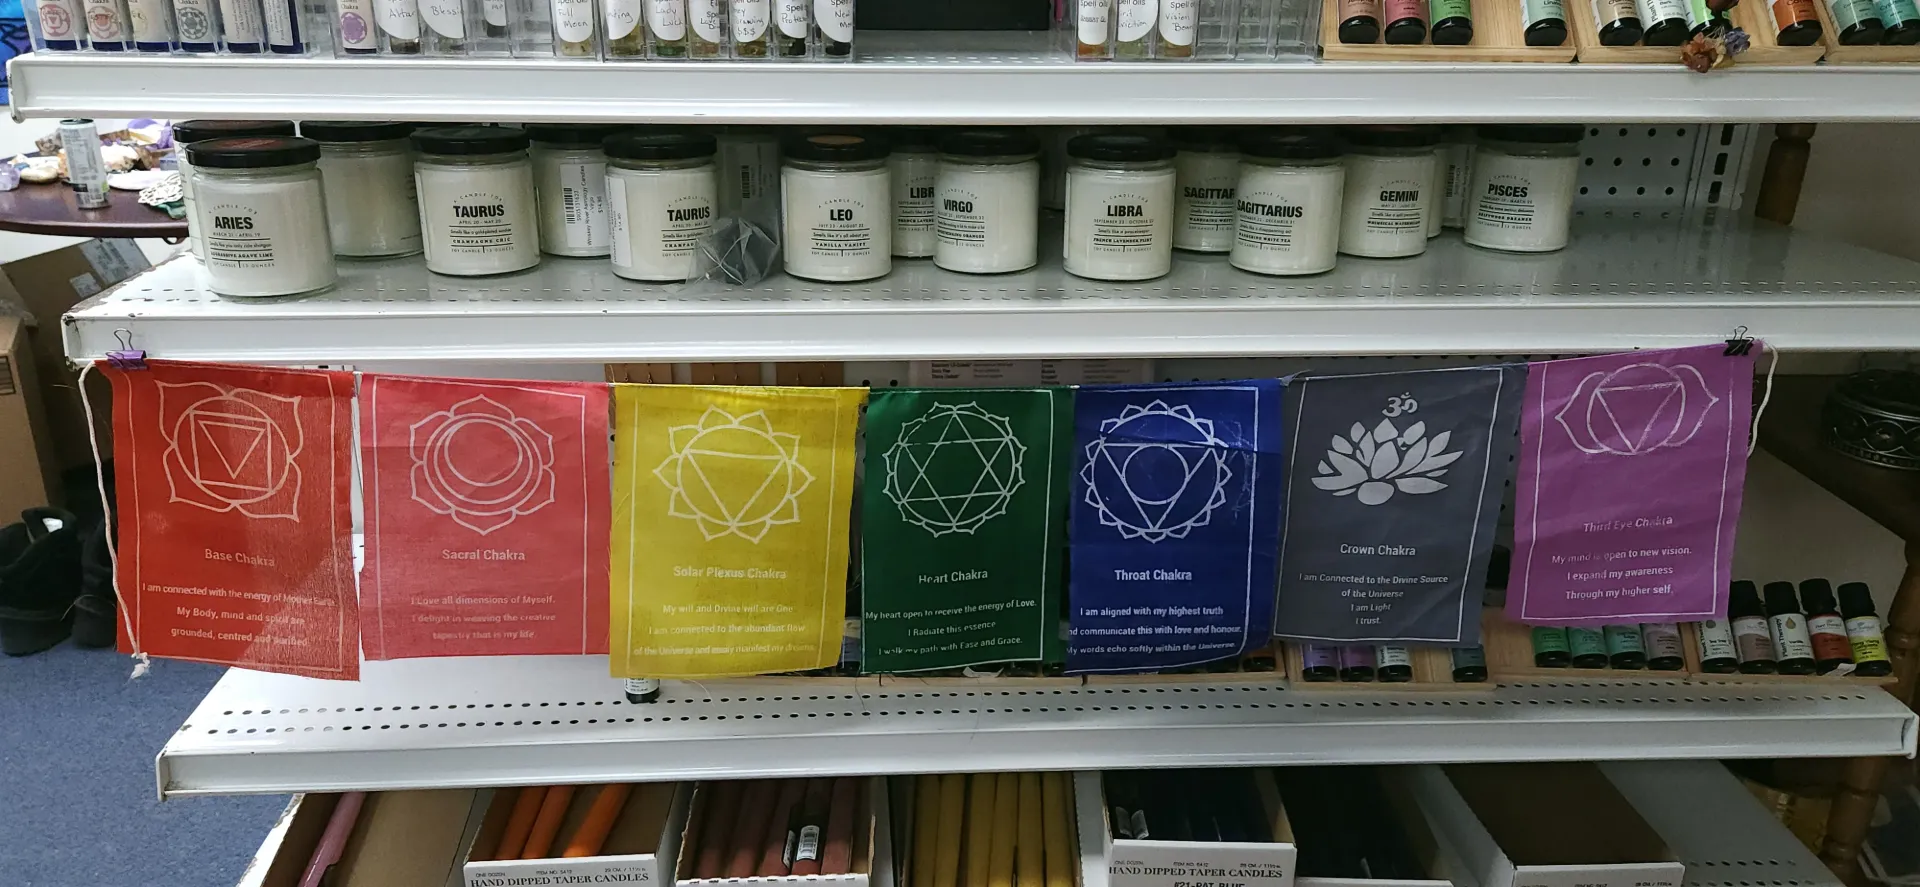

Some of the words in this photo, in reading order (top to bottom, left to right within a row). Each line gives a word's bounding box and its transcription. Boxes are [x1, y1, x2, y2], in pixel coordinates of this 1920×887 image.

[655, 3, 677, 17] Lady
[1165, 12, 1190, 20] Vision
[910, 187, 934, 199] LIBR
[1380, 190, 1419, 202] GEMINI
[1488, 183, 1528, 198] PISCES
[453, 204, 504, 218] TAURUS
[944, 198, 973, 213] VIRGO
[1107, 205, 1143, 217] LIBRA
[1237, 199, 1303, 218] SAGITTARIUS
[667, 206, 710, 222] TAURUS
[830, 209, 853, 221] LEO
[215, 216, 253, 230] ARIES
[1613, 520, 1633, 530] Eye
[1635, 516, 1673, 528] Chakra
[442, 549, 480, 561] Sacral
[483, 549, 525, 561] Chakra
[1340, 543, 1375, 555] Crown
[1378, 544, 1416, 556] Chakra
[1551, 554, 1566, 565] My
[1567, 553, 1591, 563] mind
[1603, 550, 1627, 562] open
[1628, 549, 1638, 558] to
[1640, 548, 1659, 557] new
[1661, 546, 1692, 556] vision.
[205, 548, 233, 562] Base
[235, 552, 275, 567] Chakra
[673, 566, 702, 578] Solar
[706, 567, 744, 578] Plexus
[746, 567, 787, 580] Chakra
[918, 573, 949, 584] Heart
[951, 569, 988, 582] Chakra
[1114, 569, 1151, 581] Throat
[1153, 568, 1192, 581] Chakra
[1303, 574, 1317, 582] am
[1319, 573, 1365, 584] Connected
[1366, 575, 1376, 584] to
[1377, 575, 1391, 584] the
[1392, 574, 1418, 584] Divine
[1419, 575, 1448, 583] Source
[1572, 569, 1607, 582] expand
[1609, 569, 1623, 580] my
[1625, 566, 1674, 578] awareness
[147, 584, 161, 593] am
[163, 585, 207, 596] connected
[209, 587, 226, 597] with
[228, 588, 242, 598] the
[243, 591, 271, 603] energy
[273, 592, 282, 602] of
[1341, 589, 1351, 597] of
[1352, 589, 1367, 598] the
[1368, 589, 1404, 598] Universe
[1566, 589, 1604, 601] Through
[1605, 588, 1620, 599] my
[1622, 586, 1651, 597] higher
[417, 596, 440, 605] Love
[441, 596, 454, 605] all
[455, 595, 508, 605] dimensions
[510, 595, 520, 604] of
[522, 595, 556, 606] Myself.
[177, 606, 191, 618] My
[193, 607, 219, 620] Body,
[221, 610, 244, 620] mind
[246, 611, 263, 622] and
[663, 604, 676, 615] My
[678, 604, 694, 614] will
[695, 604, 712, 613] and
[714, 604, 741, 613] Divine
[743, 604, 759, 613] will
[760, 605, 775, 613] are
[865, 611, 878, 620] My
[880, 610, 901, 620] heart
[903, 610, 923, 620] open
[934, 606, 963, 616] receive
[964, 605, 977, 614] the
[978, 603, 1004, 613] energy
[1005, 600, 1014, 609] of
[1015, 598, 1038, 608] Love.
[1085, 608, 1099, 616] am
[1100, 606, 1131, 618] aligned
[1133, 607, 1151, 616] with
[1152, 607, 1167, 618] my
[1168, 605, 1201, 617] highest
[1202, 606, 1224, 615] truth
[1370, 603, 1391, 612] Light
[503, 613, 519, 622] the
[520, 613, 556, 622] creative
[1360, 617, 1382, 625] trust.
[171, 627, 216, 640] grounded,
[217, 631, 252, 642] centred
[670, 625, 715, 635] connected
[717, 625, 726, 634] to
[728, 624, 742, 633] the
[744, 624, 785, 633] abundant
[913, 625, 945, 637] Radiate
[946, 624, 962, 634] this
[964, 620, 996, 632] essence
[1068, 627, 1078, 636] nd
[1079, 626, 1136, 636] communicate
[1137, 625, 1153, 635] this
[1154, 625, 1173, 635] with
[1174, 625, 1192, 634] love
[1194, 624, 1210, 634] and
[1210, 624, 1242, 634] honour.
[503, 631, 518, 640] my
[940, 642, 958, 652] with
[980, 638, 996, 647] and
[997, 636, 1023, 646] Grace.
[1080, 645, 1105, 654] words
[1106, 645, 1127, 653] echo
[1129, 644, 1153, 654] softly
[1155, 644, 1181, 652] within
[1183, 643, 1196, 651] the
[1109, 866, 1141, 875] HAND
[1144, 868, 1187, 876] DIPPED
[1189, 869, 1226, 877] TAPER
[1228, 869, 1283, 878] CANDLES
[471, 879, 504, 887] HAND
[507, 877, 550, 885] DIPPED
[553, 875, 592, 884] TAPER
[594, 873, 649, 883] CANDLES
